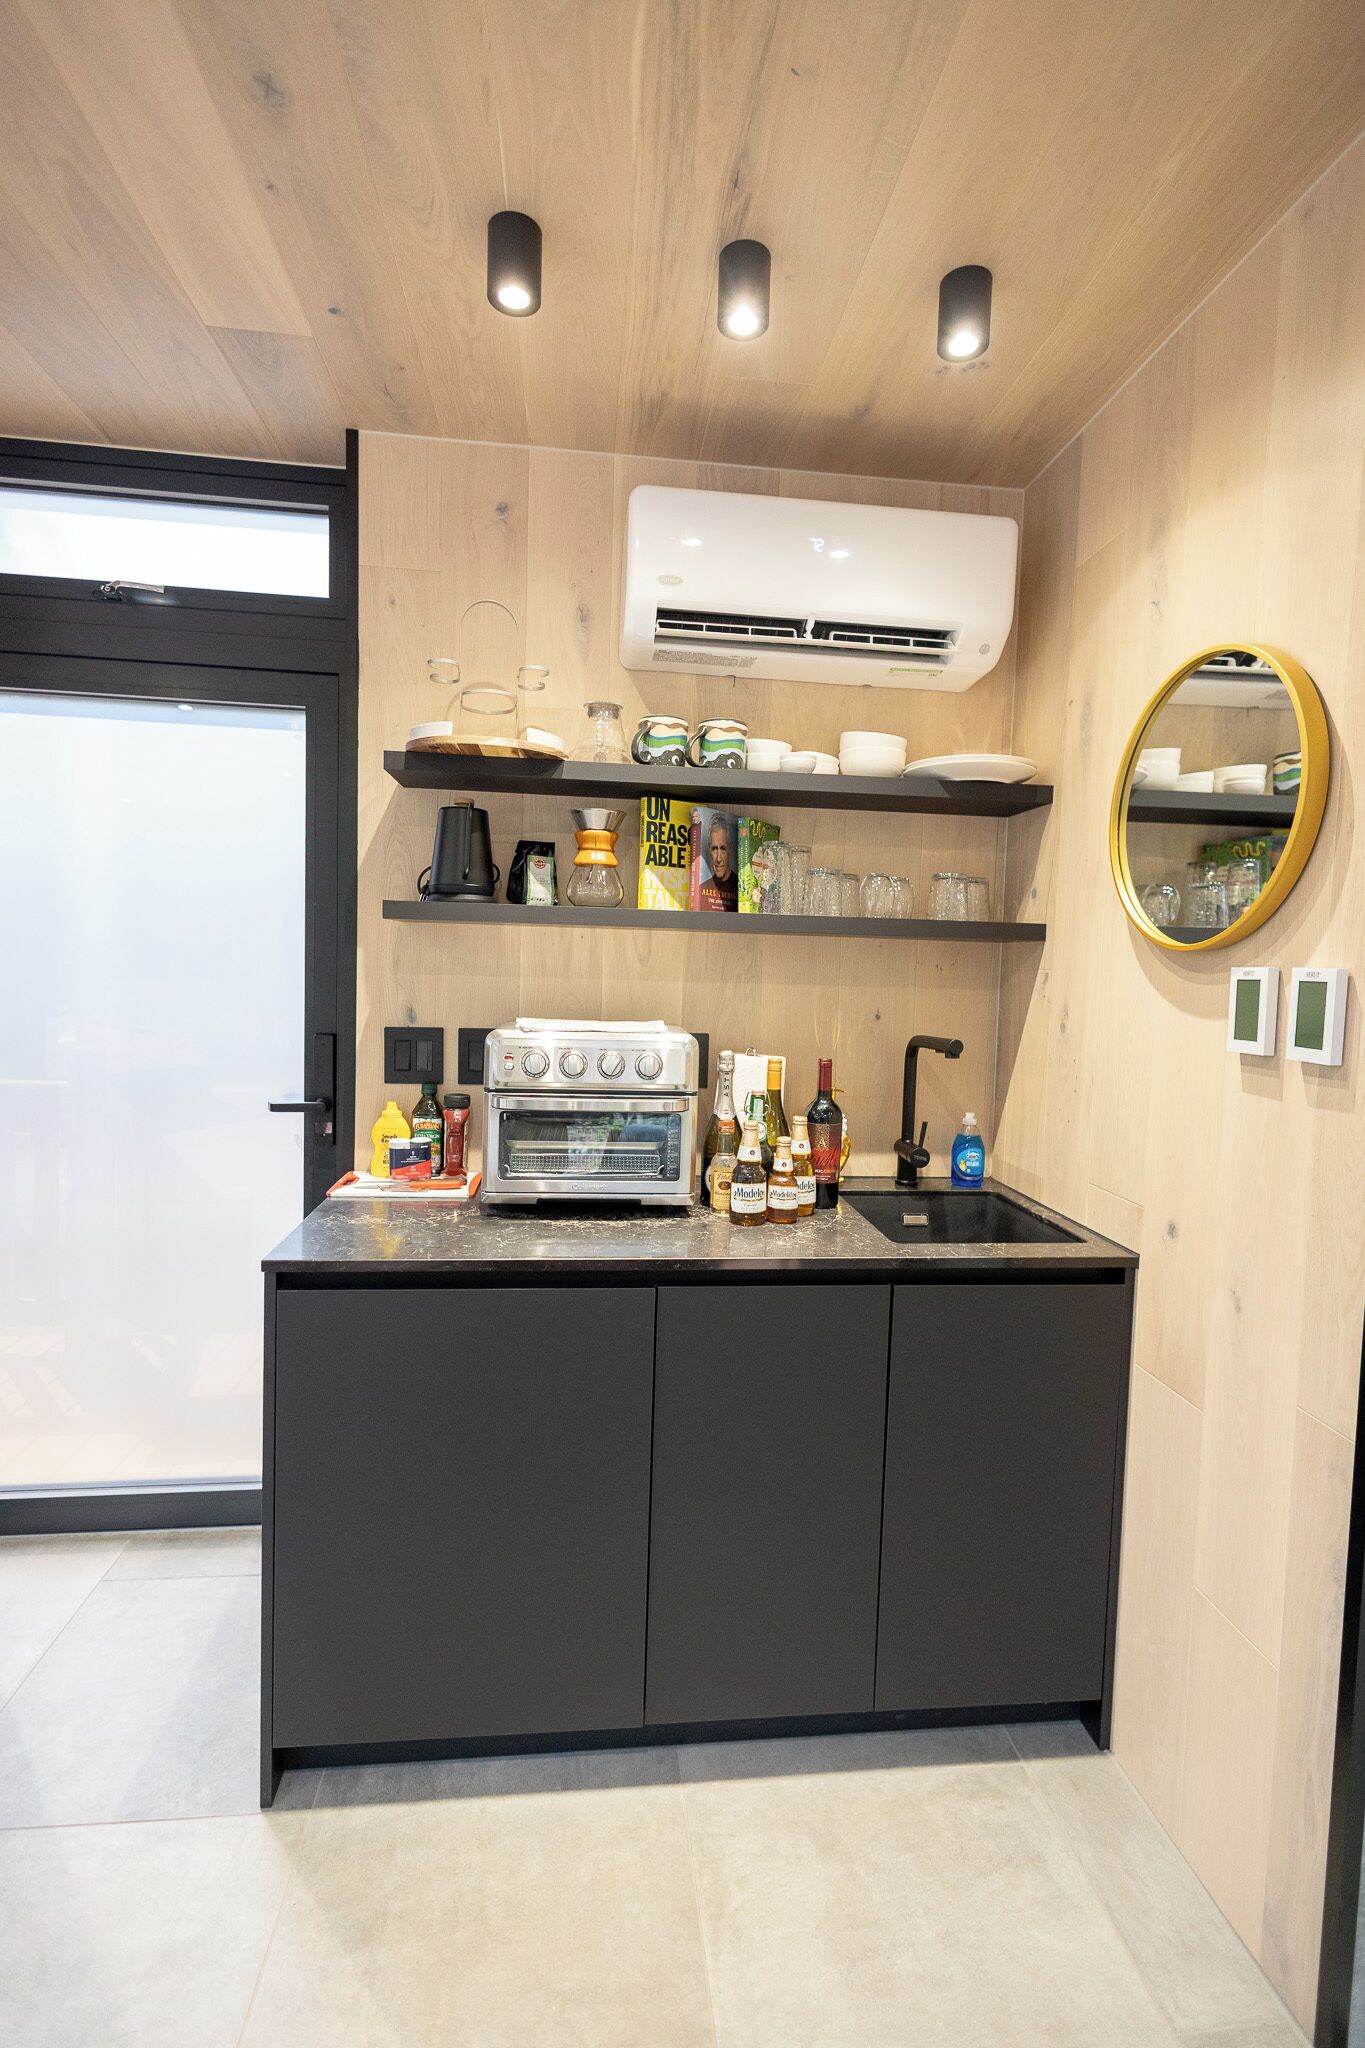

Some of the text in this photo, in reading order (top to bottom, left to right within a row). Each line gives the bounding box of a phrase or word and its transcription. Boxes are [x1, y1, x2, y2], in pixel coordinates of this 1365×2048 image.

[646, 797, 671, 821] UN
[646, 821, 691, 846] REAS
[645, 844, 686, 868] ABLE
[644, 866, 689, 890] HOSP
[643, 889, 689, 911] TALIT
[702, 889, 716, 897] ALEX
